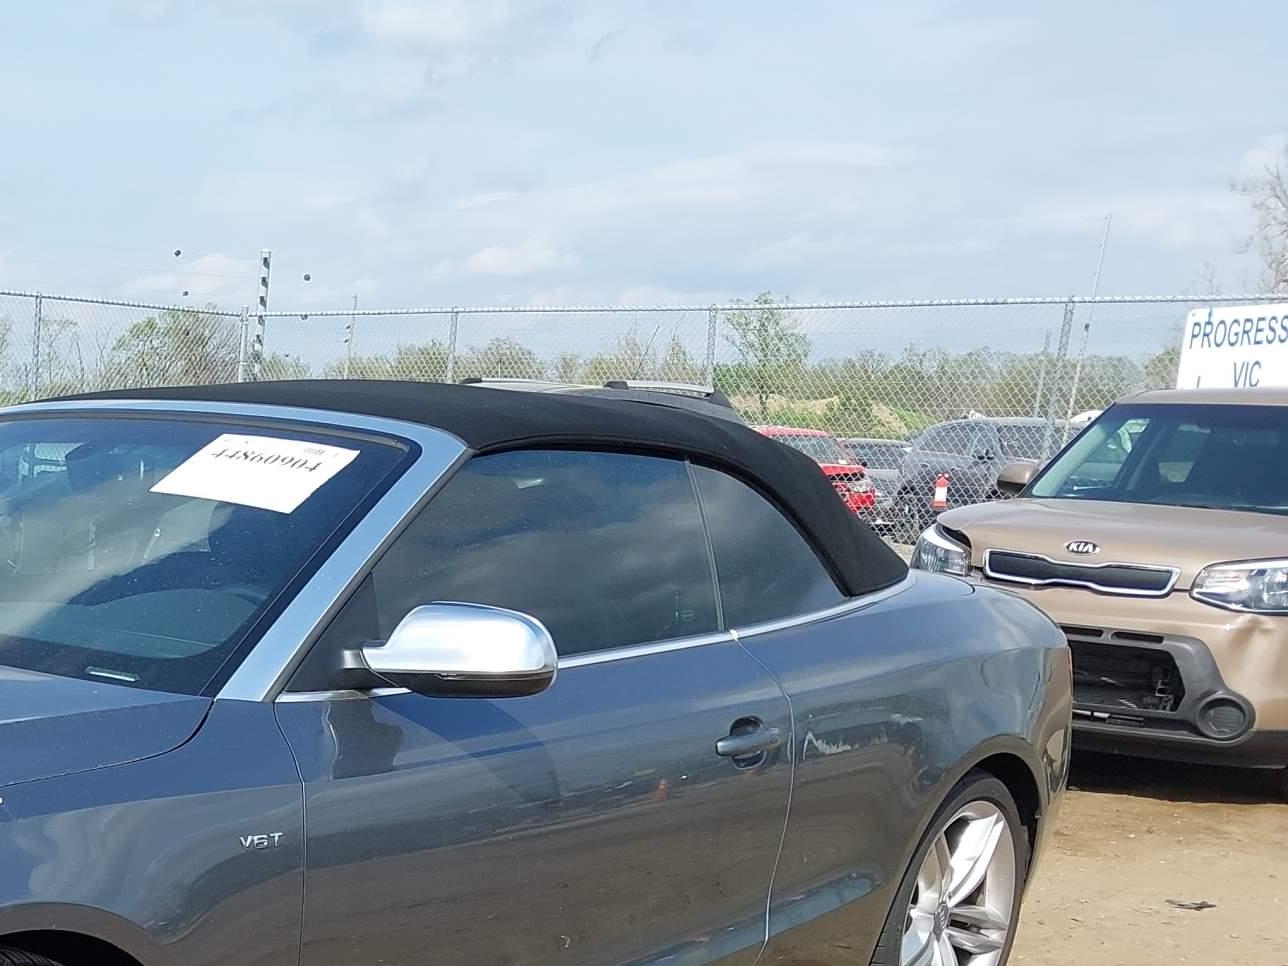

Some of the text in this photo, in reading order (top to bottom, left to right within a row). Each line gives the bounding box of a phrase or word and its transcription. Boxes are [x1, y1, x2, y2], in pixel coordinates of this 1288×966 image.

[211, 447, 323, 473] 44860904
[1068, 542, 1094, 553] KIA
[239, 832, 284, 849] V6T
